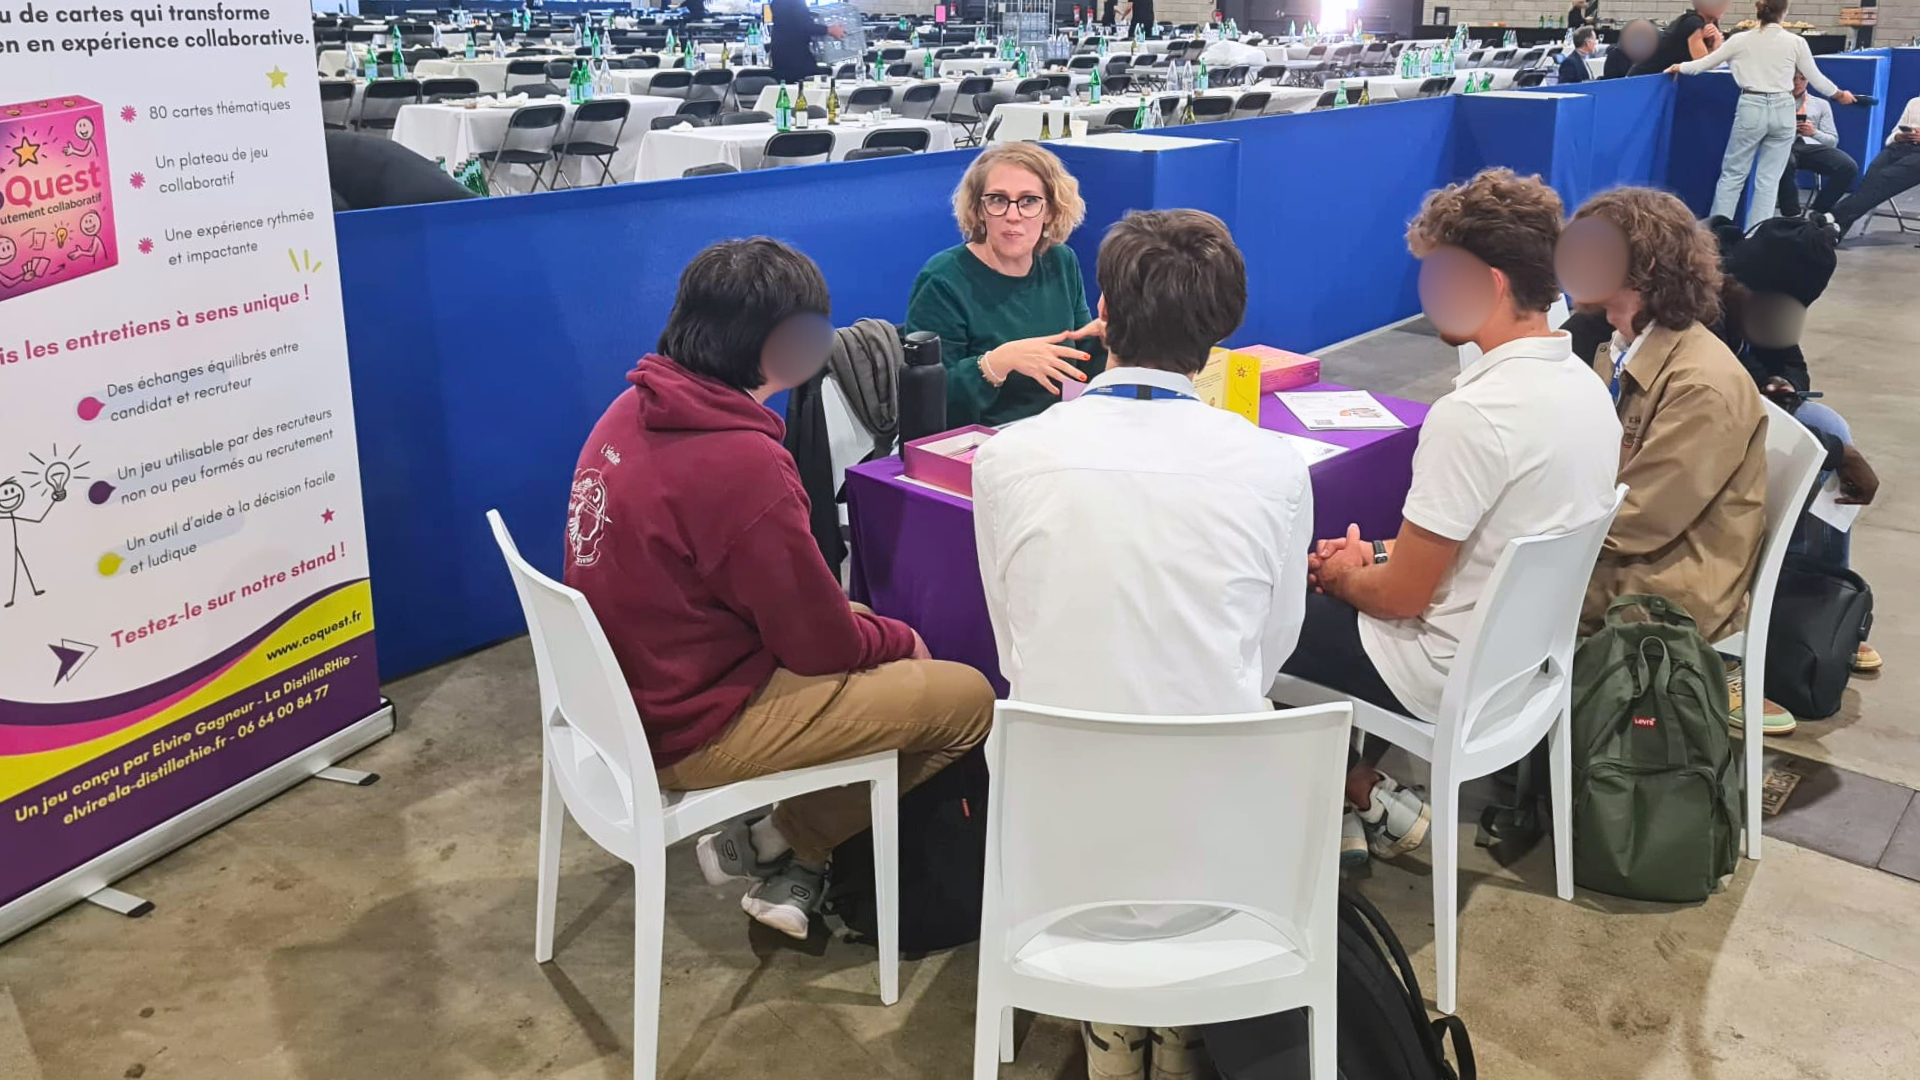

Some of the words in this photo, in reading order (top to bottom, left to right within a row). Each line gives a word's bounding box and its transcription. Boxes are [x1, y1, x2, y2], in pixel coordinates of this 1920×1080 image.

[19, 2, 48, 23] de
[56, 5, 124, 22] cartes
[130, 4, 163, 27] qui
[169, 2, 270, 21] transforme
[27, 39, 55, 52] en
[61, 31, 179, 57] expérience
[185, 28, 310, 48] collaborative.
[149, 106, 168, 119] 80
[172, 105, 214, 118] cartes
[217, 100, 291, 114] thématiques
[155, 155, 175, 169] Un
[179, 152, 229, 170] plateau
[232, 147, 247, 161] de
[249, 148, 268, 163] jeu
[0, 161, 101, 207] Quest
[47, 192, 102, 214] collaboratif
[159, 172, 235, 193] collaboratif
[165, 228, 193, 242] Une
[197, 218, 264, 239] expérience
[267, 209, 314, 229] rythmée
[168, 253, 182, 265] et
[187, 242, 258, 263] impactante
[25, 340, 59, 359] les
[65, 319, 171, 350] entretiens
[176, 310, 190, 327] à
[195, 305, 239, 323] sens
[243, 292, 300, 313] unique
[304, 284, 310, 300] !
[107, 383, 134, 397] Des
[138, 366, 204, 390] échanges
[208, 350, 267, 373] équilibrés
[270, 342, 299, 357] entre
[110, 396, 172, 421] candidat
[176, 391, 190, 404] et
[194, 377, 252, 400] recruteur
[117, 466, 137, 480] Un
[140, 459, 161, 478] jeu
[165, 439, 224, 466] utilisable
[228, 434, 249, 452] par
[252, 426, 273, 440] des
[276, 409, 332, 433] recruteurs
[121, 488, 147, 505] non
[150, 482, 168, 495] ou
[172, 474, 197, 493] peu
[200, 457, 244, 479] formés
[247, 453, 263, 465] au
[266, 429, 333, 459] recrutement
[126, 536, 146, 551] Un
[149, 522, 178, 543] outil
[182, 509, 223, 532] d'aide
[226, 505, 235, 517] à
[238, 500, 250, 513] la
[253, 484, 302, 508] décision
[304, 471, 335, 490] facile
[129, 560, 144, 574] et
[148, 543, 197, 568] ludique
[110, 602, 202, 648] Testez-le
[207, 590, 236, 610] sur
[241, 571, 286, 597] notre
[290, 545, 336, 577] stand
[340, 541, 346, 557] !
[266, 610, 362, 661] www.coquest.fr
[237, 722, 255, 738] 06
[257, 711, 275, 728] 64
[277, 702, 294, 719] 00
[296, 693, 313, 710] 84
[314, 684, 330, 699] 77
[15, 804, 39, 822] Un
[42, 790, 68, 815] jeu
[72, 766, 119, 796] conçu
[123, 751, 150, 776] par
[152, 731, 192, 757] Elvire
[195, 701, 254, 735] Gagneur
[265, 689, 281, 704] La
[283, 655, 351, 695] DistilleRHie
